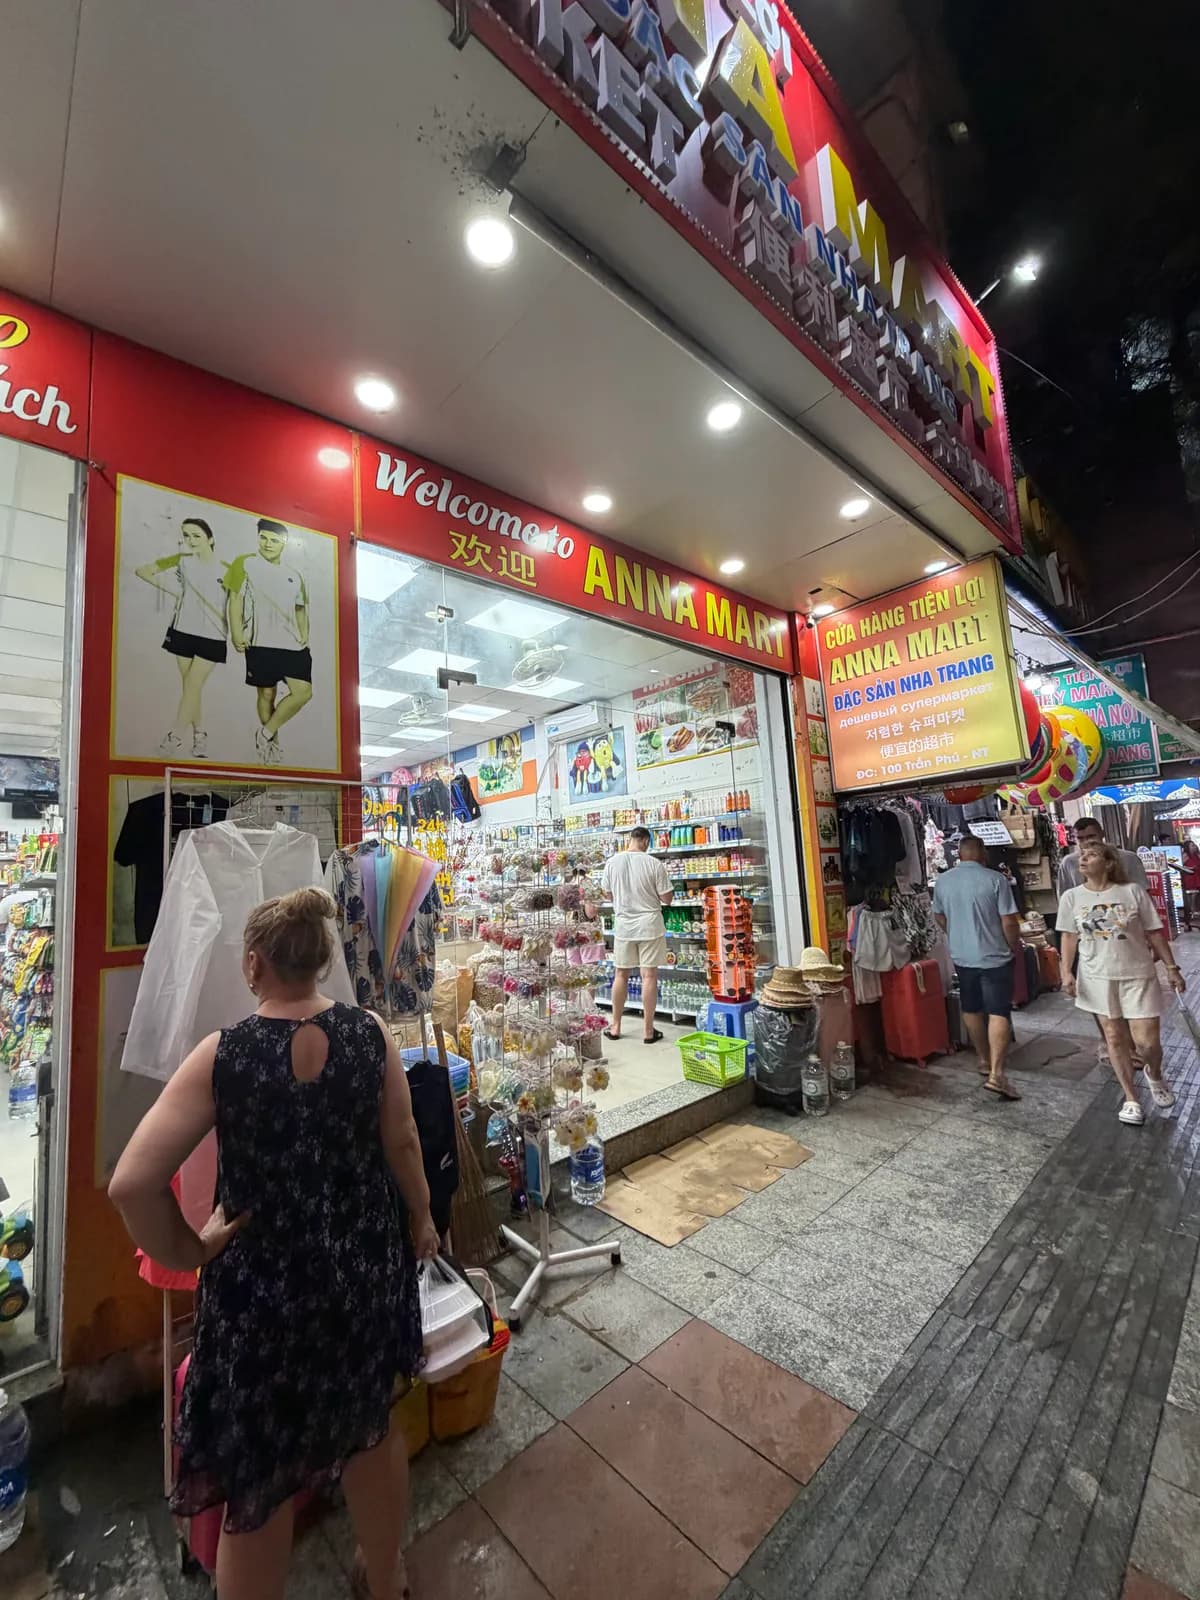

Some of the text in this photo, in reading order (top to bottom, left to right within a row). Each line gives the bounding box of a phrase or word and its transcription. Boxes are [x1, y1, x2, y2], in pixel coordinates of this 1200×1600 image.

[712, 112, 804, 237] SẢN
[805, 220, 881, 330] NHA
[816, 142, 996, 427] MART
[376, 449, 575, 560] Welcome to
[448, 530, 537, 588] 欢迎
[583, 544, 786, 660] ANNA MART
[825, 575, 986, 650] CỬA HÀNG TIỆN LỢI
[829, 612, 991, 686] ANNA MART
[833, 652, 995, 713] ĐẶC SẢN NHA TRANG
[839, 681, 994, 730] дешевый супермаркет
[865, 706, 967, 742] 저렴한 슈퍼마켓
[879, 731, 955, 760] 便宜的超市
[880, 762, 903, 776] 100
